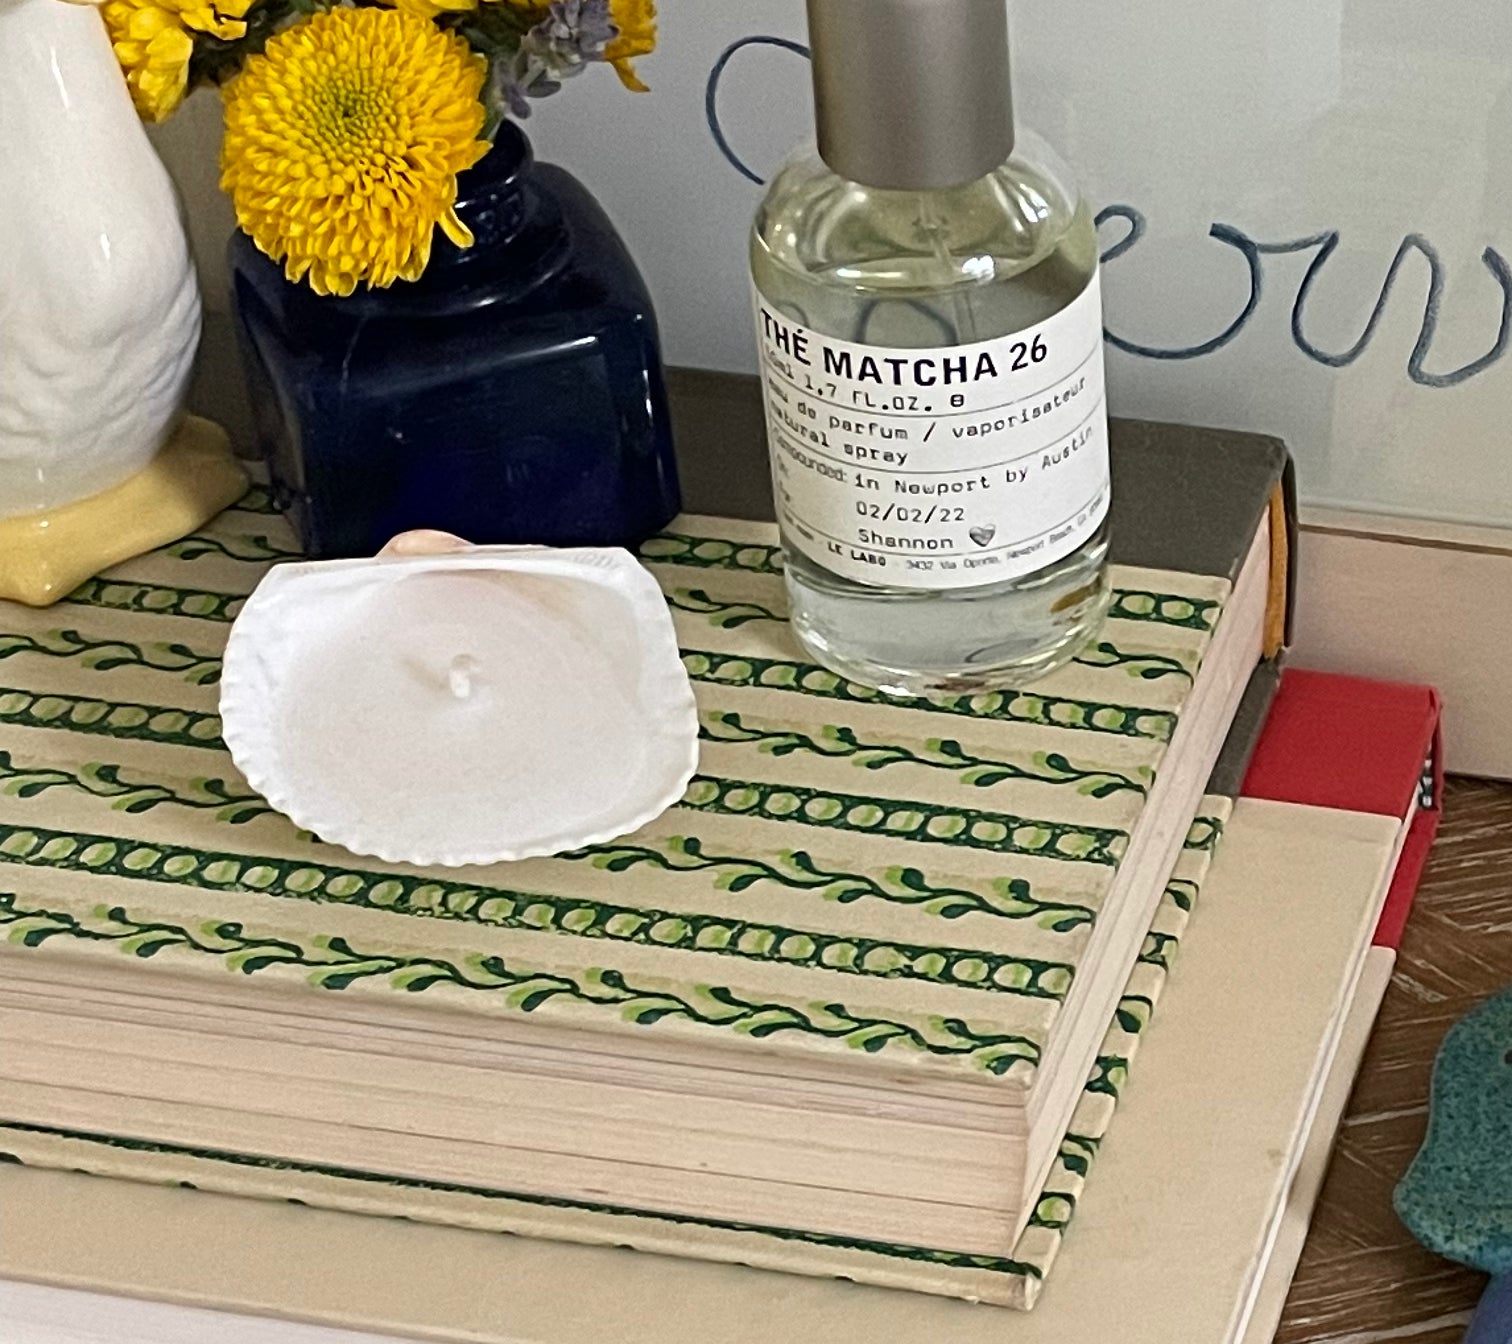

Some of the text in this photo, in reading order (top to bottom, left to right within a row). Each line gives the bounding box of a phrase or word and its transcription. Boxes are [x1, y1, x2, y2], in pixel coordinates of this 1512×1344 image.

[761, 308, 1047, 387] THÉ MATCHA 26
[805, 373, 837, 397] 1.7
[830, 415, 908, 439] parfum
[923, 422, 936, 443] /
[952, 377, 1085, 438] vaporisateur
[843, 443, 908, 466] spray
[855, 473, 879, 490] in
[894, 476, 990, 496] Newport
[1006, 467, 1028, 482] by
[1042, 426, 1093, 470] Austin
[856, 501, 965, 523] 02/02/22
[858, 529, 953, 550] Shannon
[827, 541, 843, 555] LE
[851, 550, 886, 566] LABO
